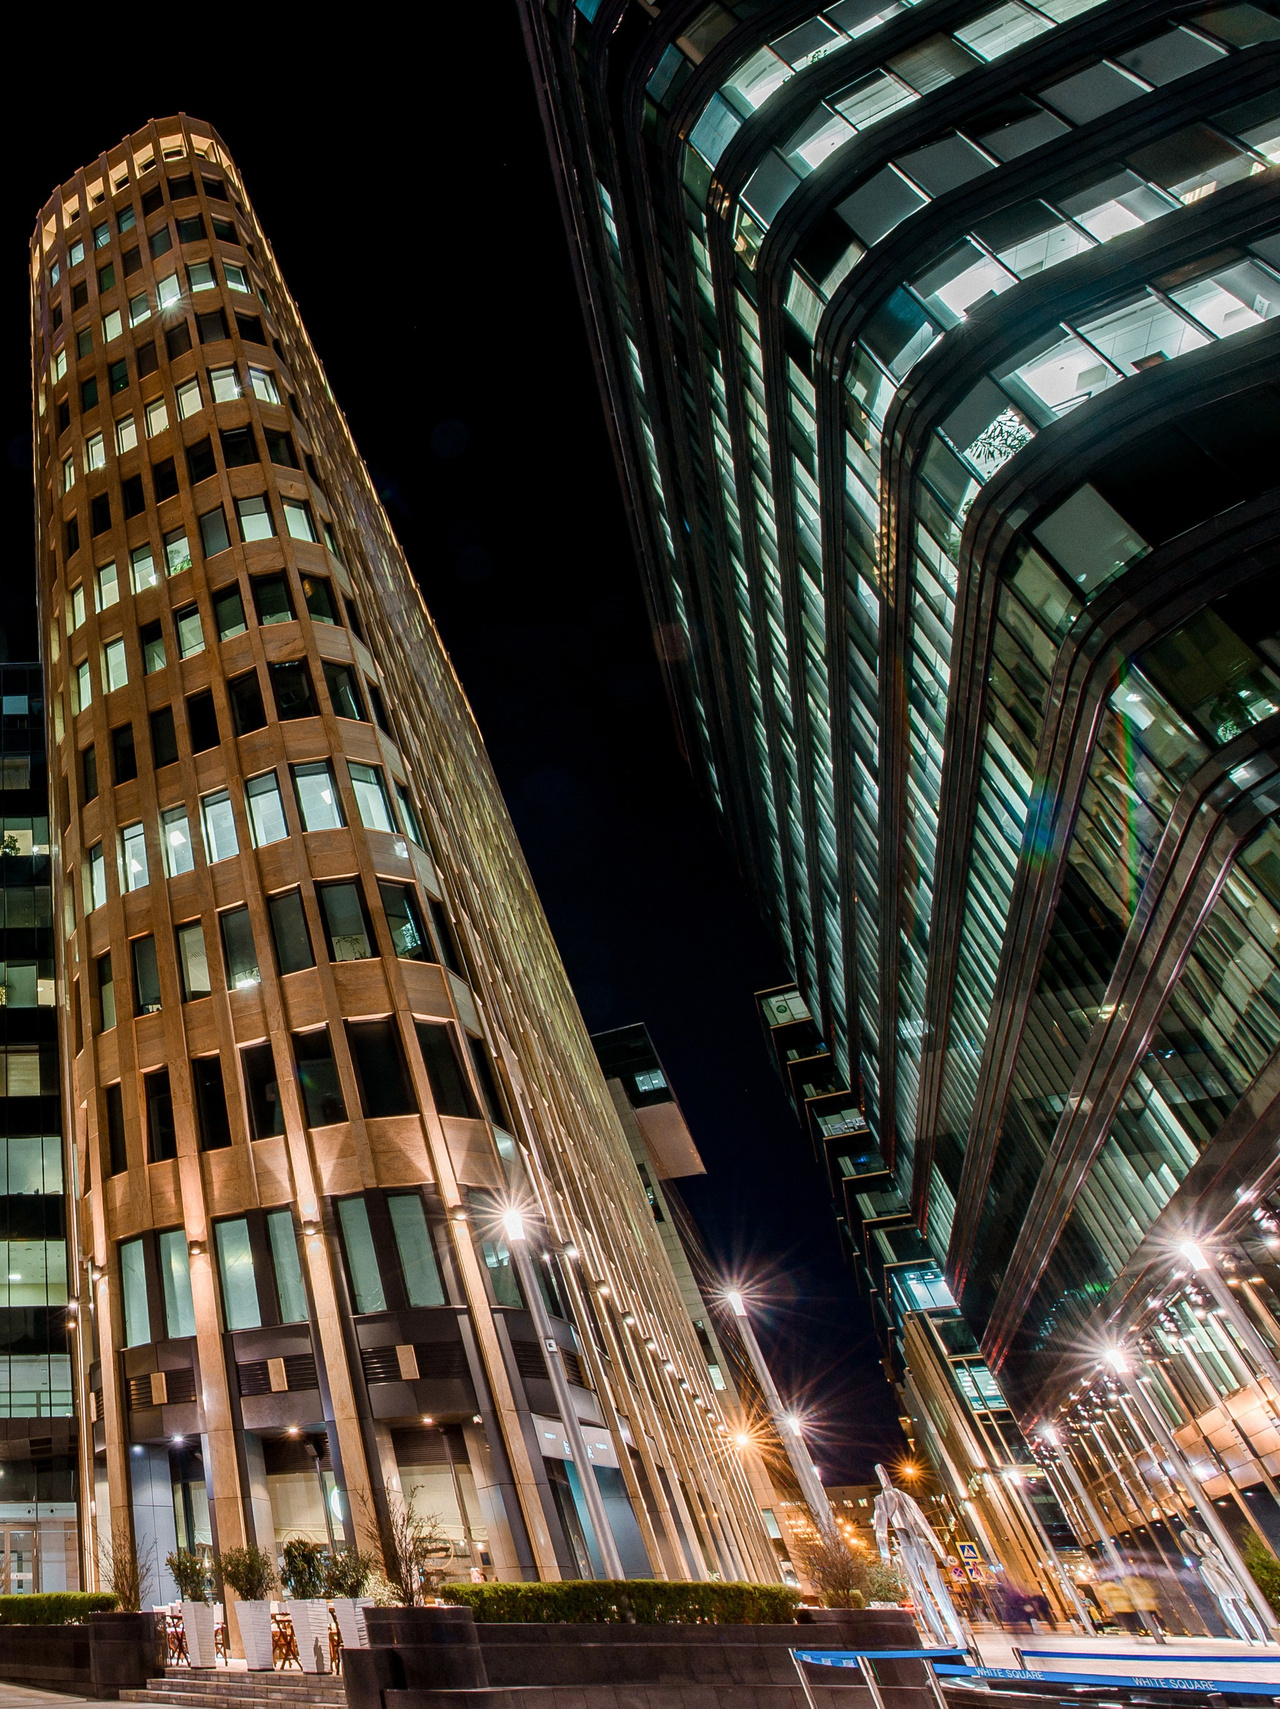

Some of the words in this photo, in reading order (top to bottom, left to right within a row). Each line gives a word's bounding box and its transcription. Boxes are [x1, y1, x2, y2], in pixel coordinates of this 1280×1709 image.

[974, 1667, 1004, 1678] WHITE
[1005, 1669, 1045, 1680] SQUARE
[1132, 1677, 1168, 1688] WHITE
[1169, 1679, 1218, 1691] SQUARE
